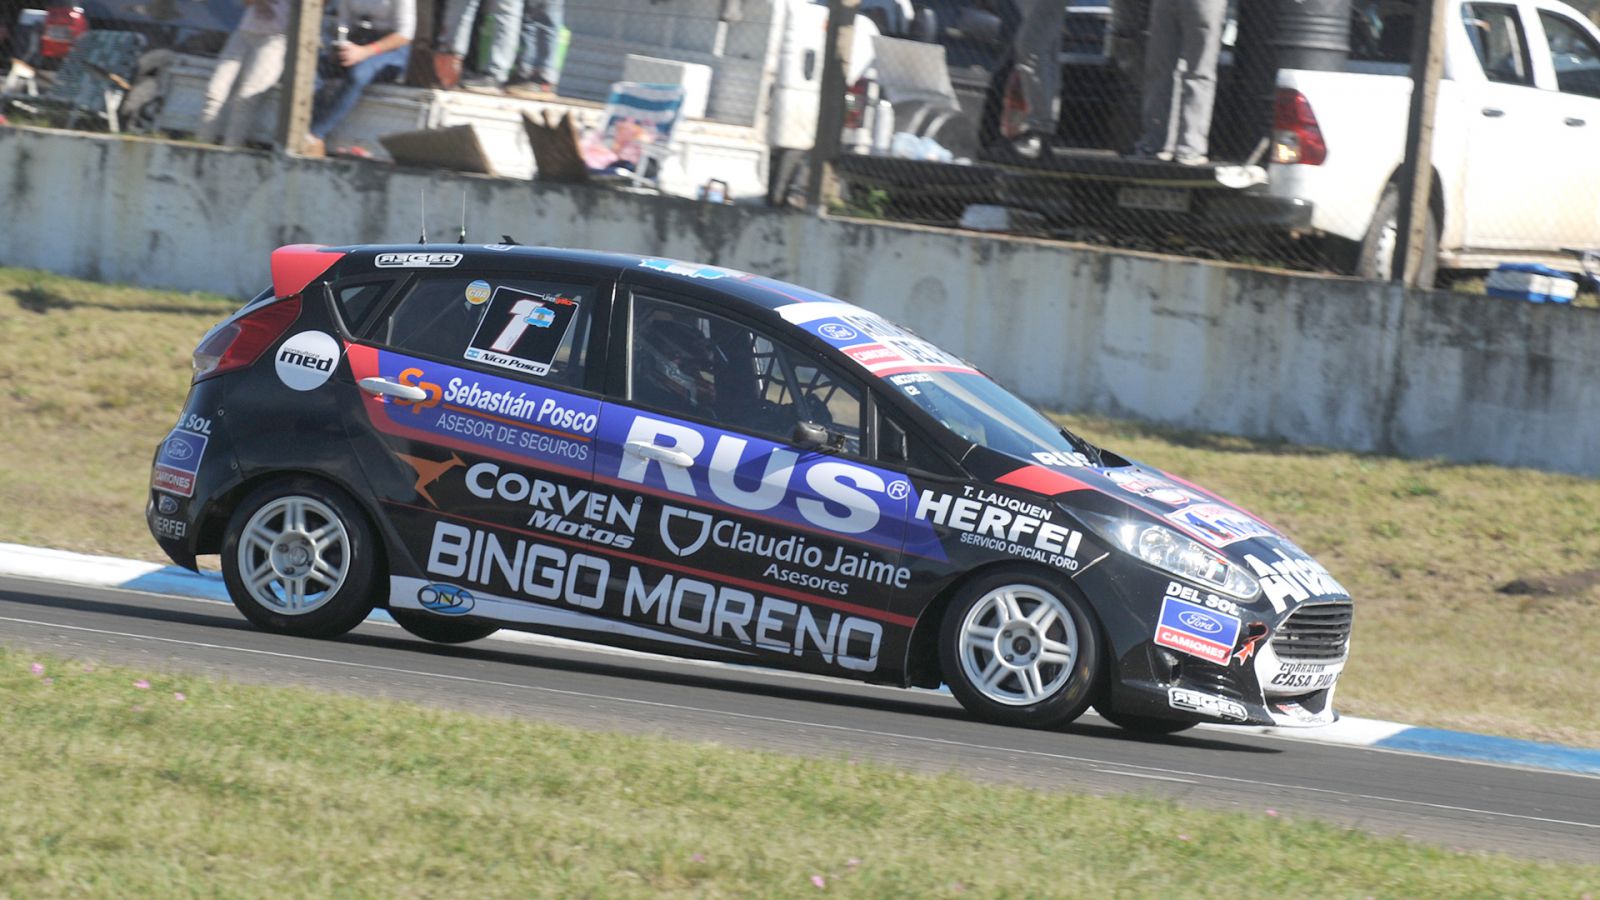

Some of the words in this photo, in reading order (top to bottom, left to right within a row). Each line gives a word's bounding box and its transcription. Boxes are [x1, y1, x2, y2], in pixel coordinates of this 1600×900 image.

[489, 299, 545, 353] 1
[280, 351, 334, 372] med
[480, 353, 508, 366] Nico
[507, 359, 546, 374] Posco
[444, 377, 535, 420] Sebastián
[537, 398, 598, 434] Posco
[185, 414, 213, 435] SOL
[436, 413, 494, 440] ASESOR
[496, 426, 518, 446] DE
[519, 431, 590, 461] SEGUROS
[963, 485, 974, 498] T.
[977, 490, 1053, 521] LAUQUEN
[527, 511, 636, 550] Motos
[914, 489, 1083, 558] HERFEI
[712, 519, 823, 568] Claudio
[824, 545, 911, 590] Jaime
[960, 532, 1007, 553] SERVICIO
[1007, 544, 1048, 564] OFICIAL
[1048, 554, 1079, 571] FORD
[426, 520, 611, 610] BINGO
[622, 566, 883, 673] MORENO
[762, 564, 850, 596] Asesores
[1166, 581, 1203, 604] DEL
[1205, 595, 1240, 617] SOL
[1185, 612, 1216, 632] Ford
[1160, 631, 1226, 659] CAMIONES
[1271, 673, 1313, 688] CASA
